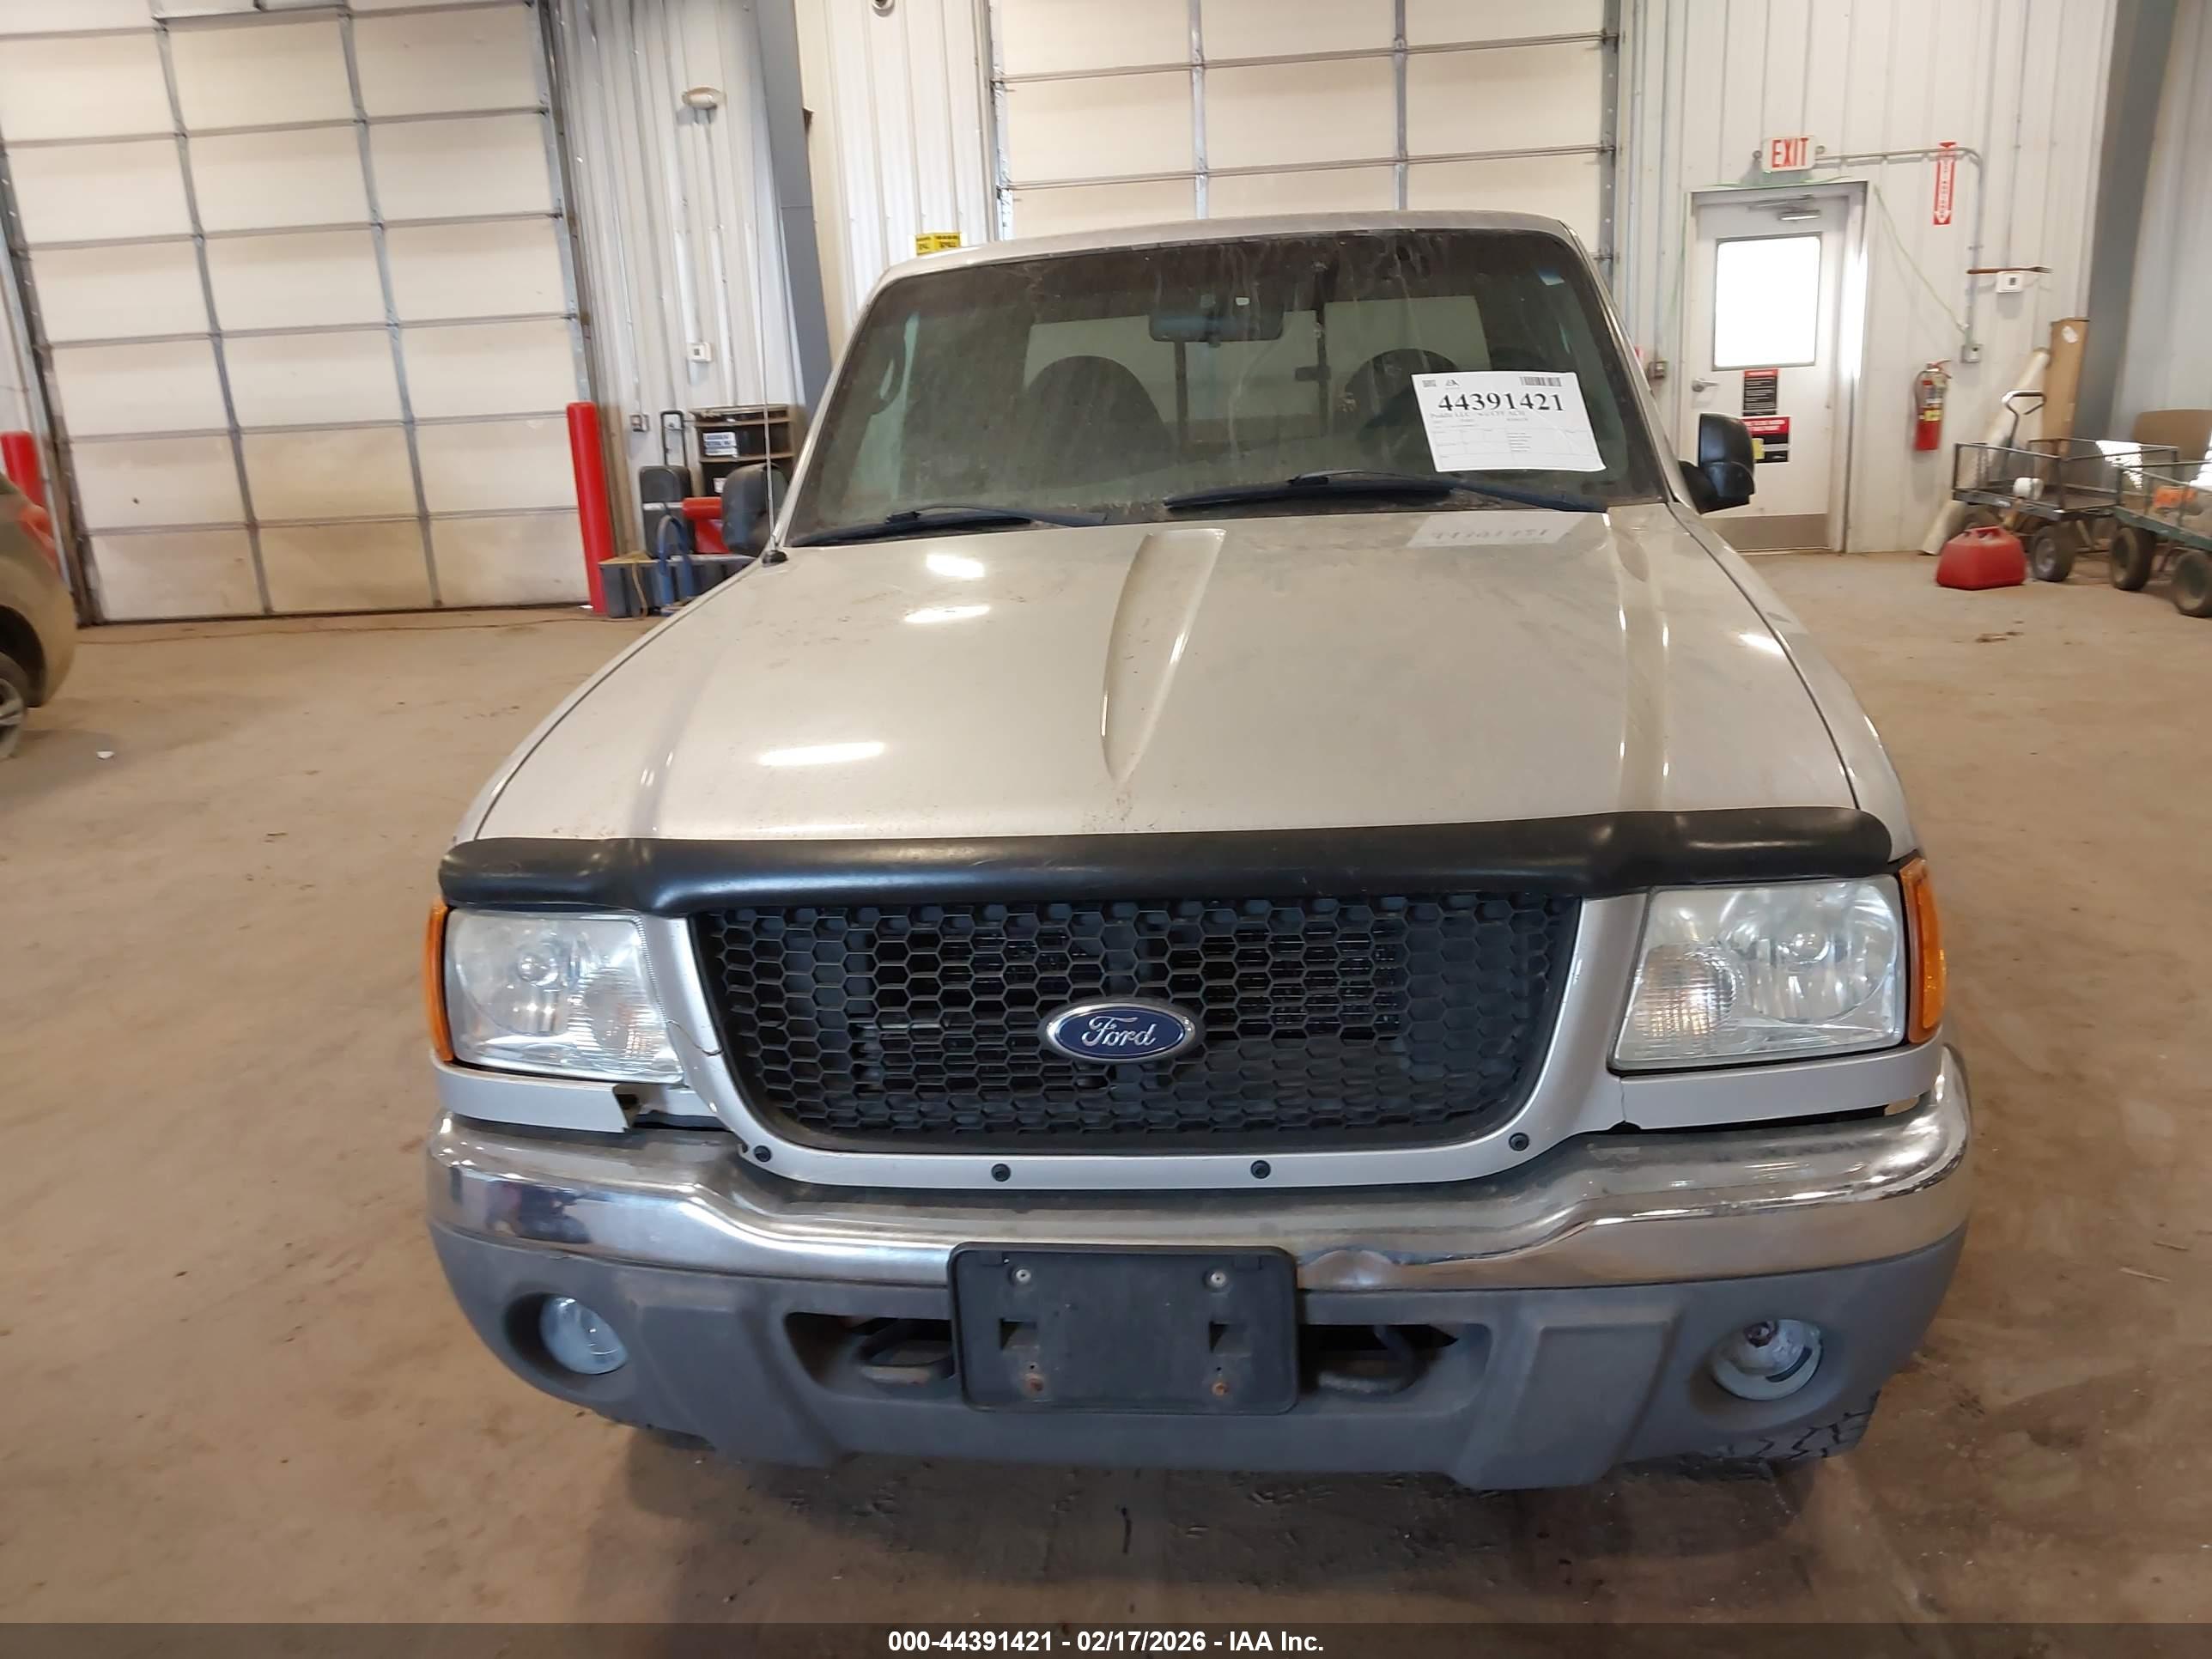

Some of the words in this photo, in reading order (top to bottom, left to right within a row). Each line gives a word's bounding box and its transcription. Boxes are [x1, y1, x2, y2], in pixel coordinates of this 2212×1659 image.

[1771, 137, 1809, 167] EXIT
[1438, 392, 1565, 411] 44391421
[1081, 1015, 1158, 1047] Ford
